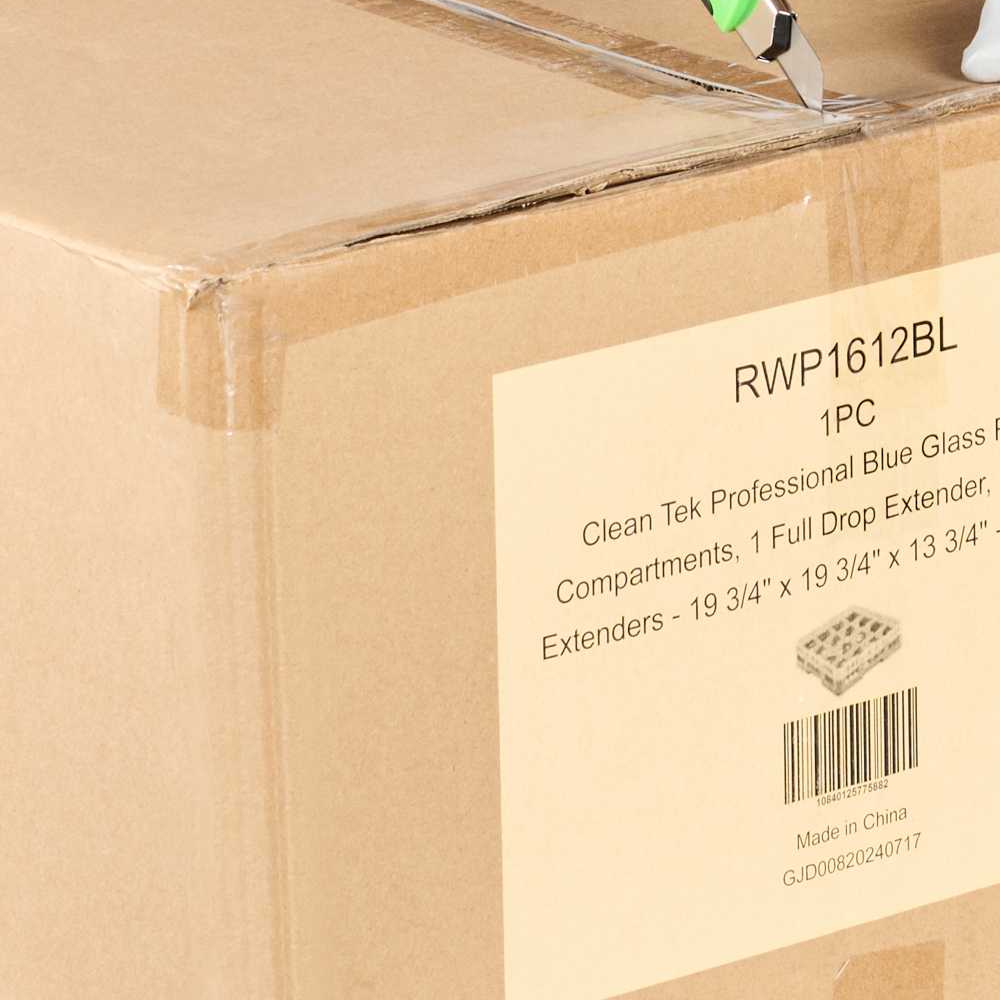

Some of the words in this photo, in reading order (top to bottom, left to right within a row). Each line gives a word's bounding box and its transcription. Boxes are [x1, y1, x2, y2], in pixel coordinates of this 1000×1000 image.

[736, 316, 958, 403] RWP1612BL
[821, 399, 876, 437] 1PC
[583, 514, 652, 546] Clean
[661, 497, 701, 526] Tek
[712, 456, 854, 514] Professional
[864, 447, 912, 475] Blue
[922, 428, 986, 458] Glass
[557, 542, 740, 605] Compartments,
[751, 530, 758, 553] 1
[772, 517, 812, 549] Full
[822, 507, 875, 537] Drop
[886, 477, 991, 519] Extender,
[543, 613, 664, 660] Extenders
[691, 593, 717, 620] 19
[727, 578, 771, 612] 3/4"
[780, 579, 791, 598] x
[802, 564, 828, 591] 19
[837, 548, 880, 582] 3/4"
[889, 549, 900, 568] x
[910, 535, 935, 561] 13
[946, 520, 987, 554] 3/4"
[783, 832, 922, 887] GJD00820240717
[797, 823, 840, 850] Made
[845, 819, 857, 836] in
[863, 807, 907, 831] China
